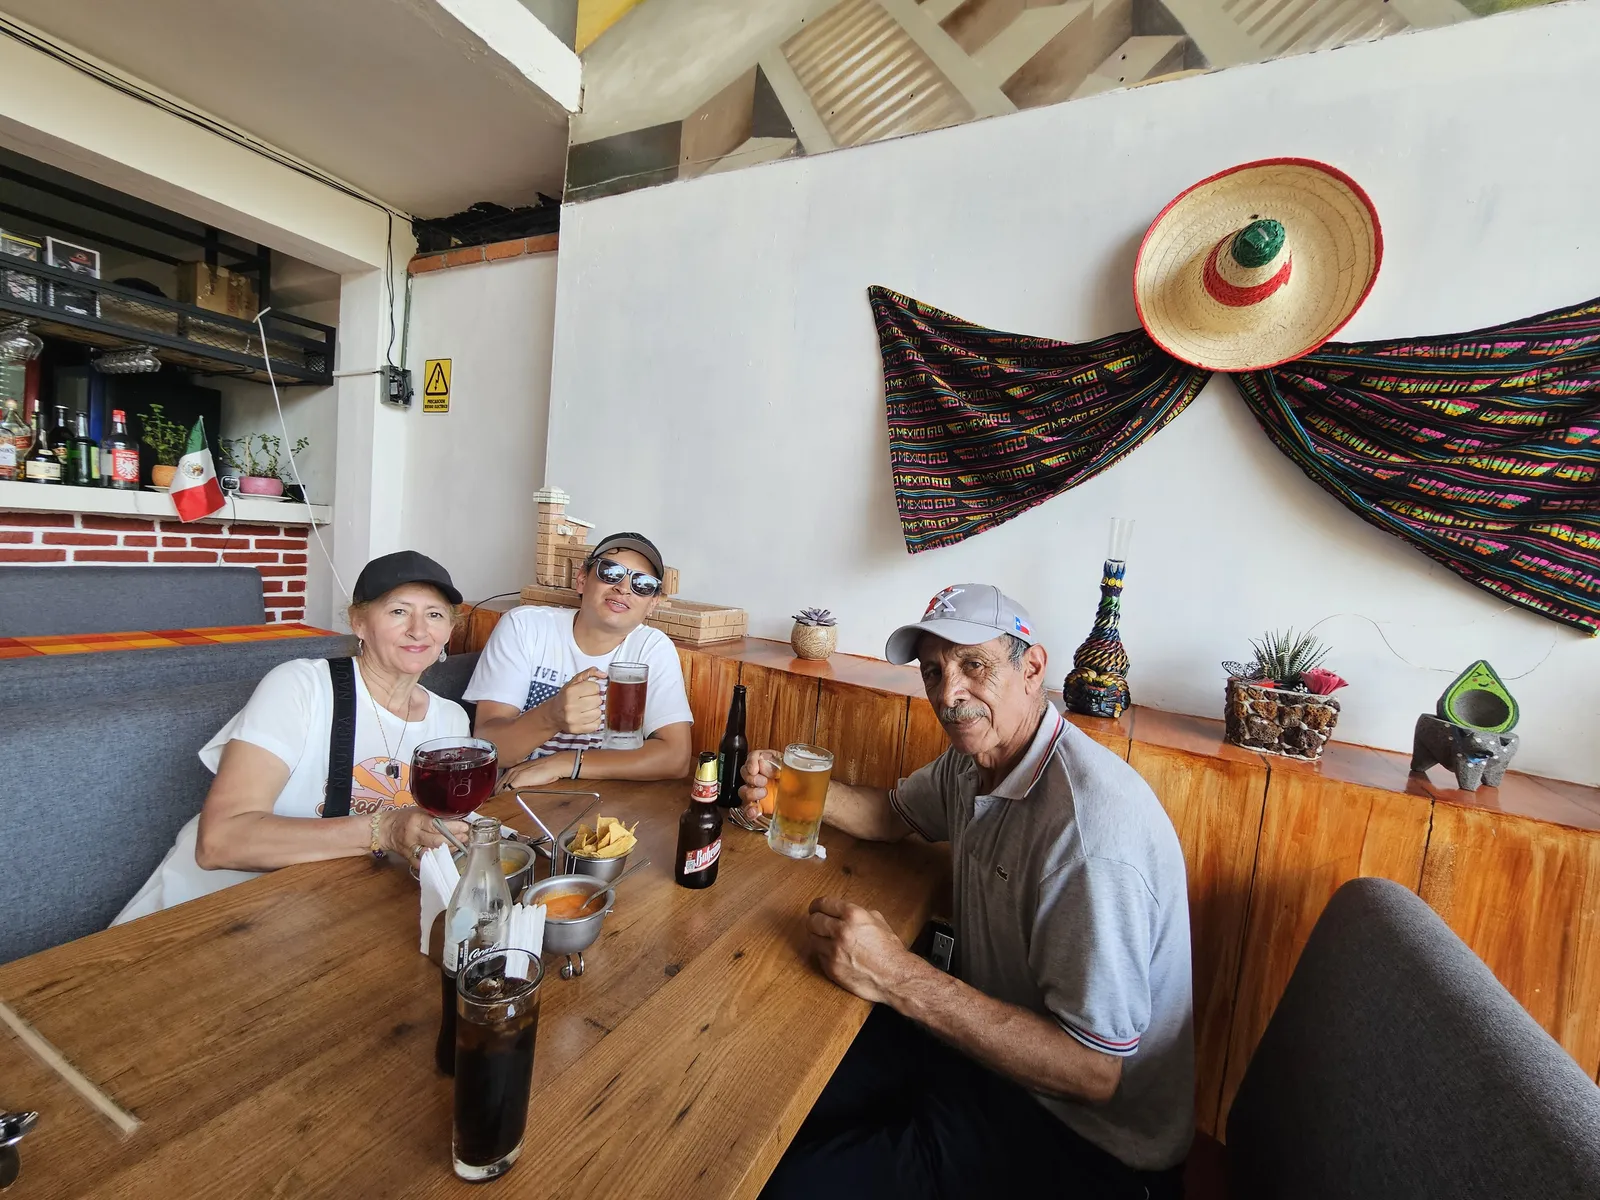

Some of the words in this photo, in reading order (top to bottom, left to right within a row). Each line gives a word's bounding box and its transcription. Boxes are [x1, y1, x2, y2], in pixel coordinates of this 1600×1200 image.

[893, 401, 923, 416] MEXICO
[1048, 393, 1083, 413] MEXICO
[1052, 411, 1088, 430] MEXICO
[896, 424, 926, 440] MEXICO
[898, 451, 928, 465] MEXICO
[900, 474, 931, 487] MEXICO
[981, 468, 1012, 484] MEXICO
[902, 498, 933, 511] MEXICO
[904, 518, 937, 533] MEXICO
[909, 539, 942, 553] MEXICO
[334, 657, 352, 700] NAUTI
[332, 715, 352, 788] NAUTICA
